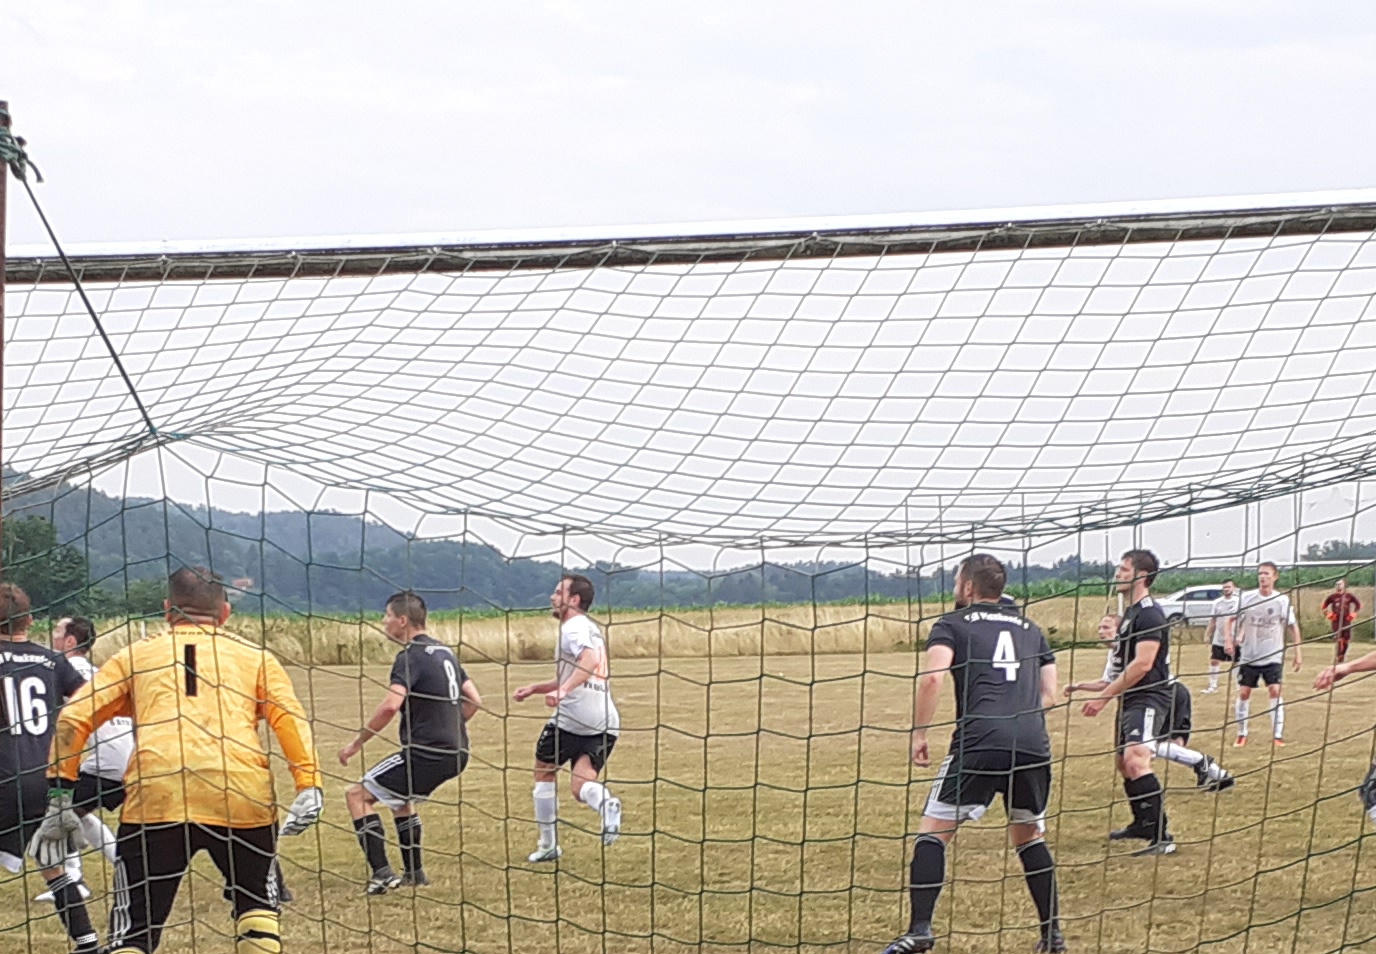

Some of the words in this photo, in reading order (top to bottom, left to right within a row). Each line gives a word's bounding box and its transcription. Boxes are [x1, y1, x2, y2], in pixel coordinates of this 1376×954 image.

[184, 644, 198, 697] 1
[992, 630, 1021, 681] 4
[3, 676, 49, 736] 16
[443, 659, 460, 705] 8
